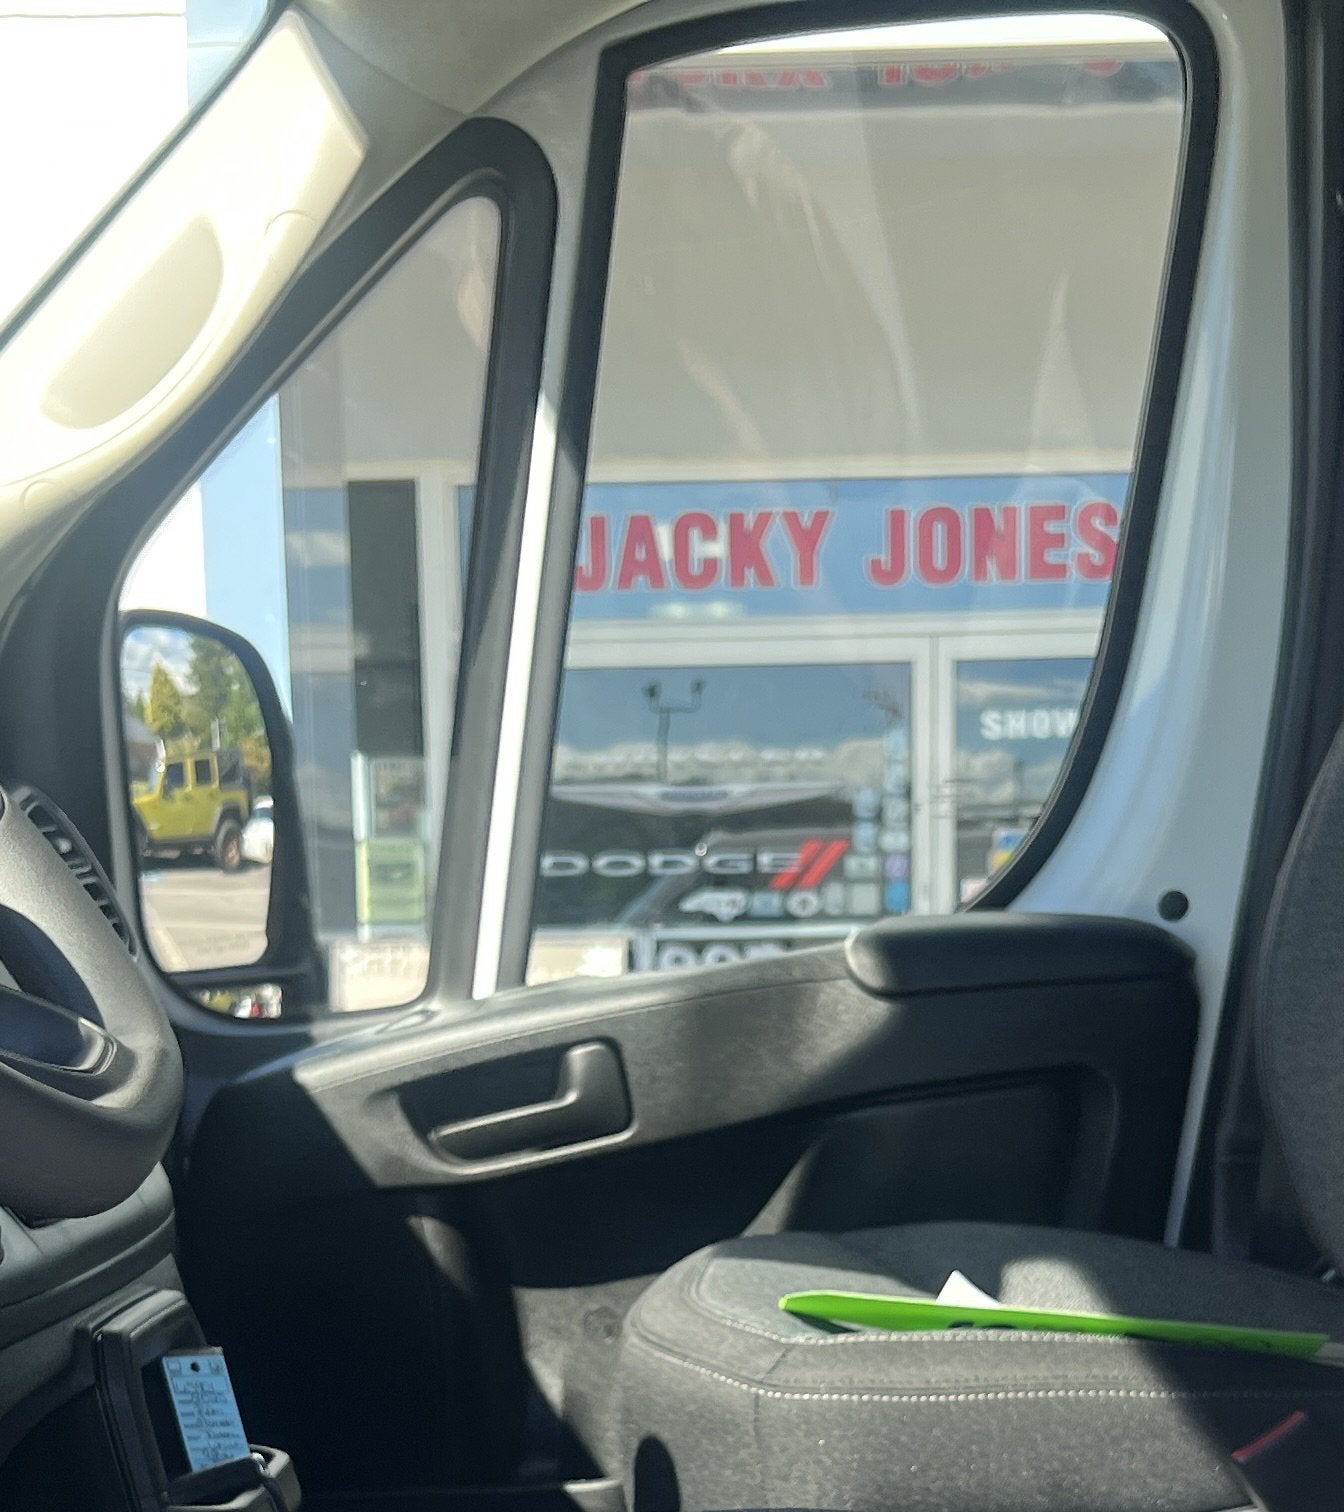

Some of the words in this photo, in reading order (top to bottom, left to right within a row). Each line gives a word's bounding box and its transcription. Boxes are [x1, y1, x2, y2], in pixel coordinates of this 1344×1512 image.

[575, 508, 833, 593] JACKY
[868, 500, 1119, 588] JONES
[540, 848, 802, 878] DODGE
